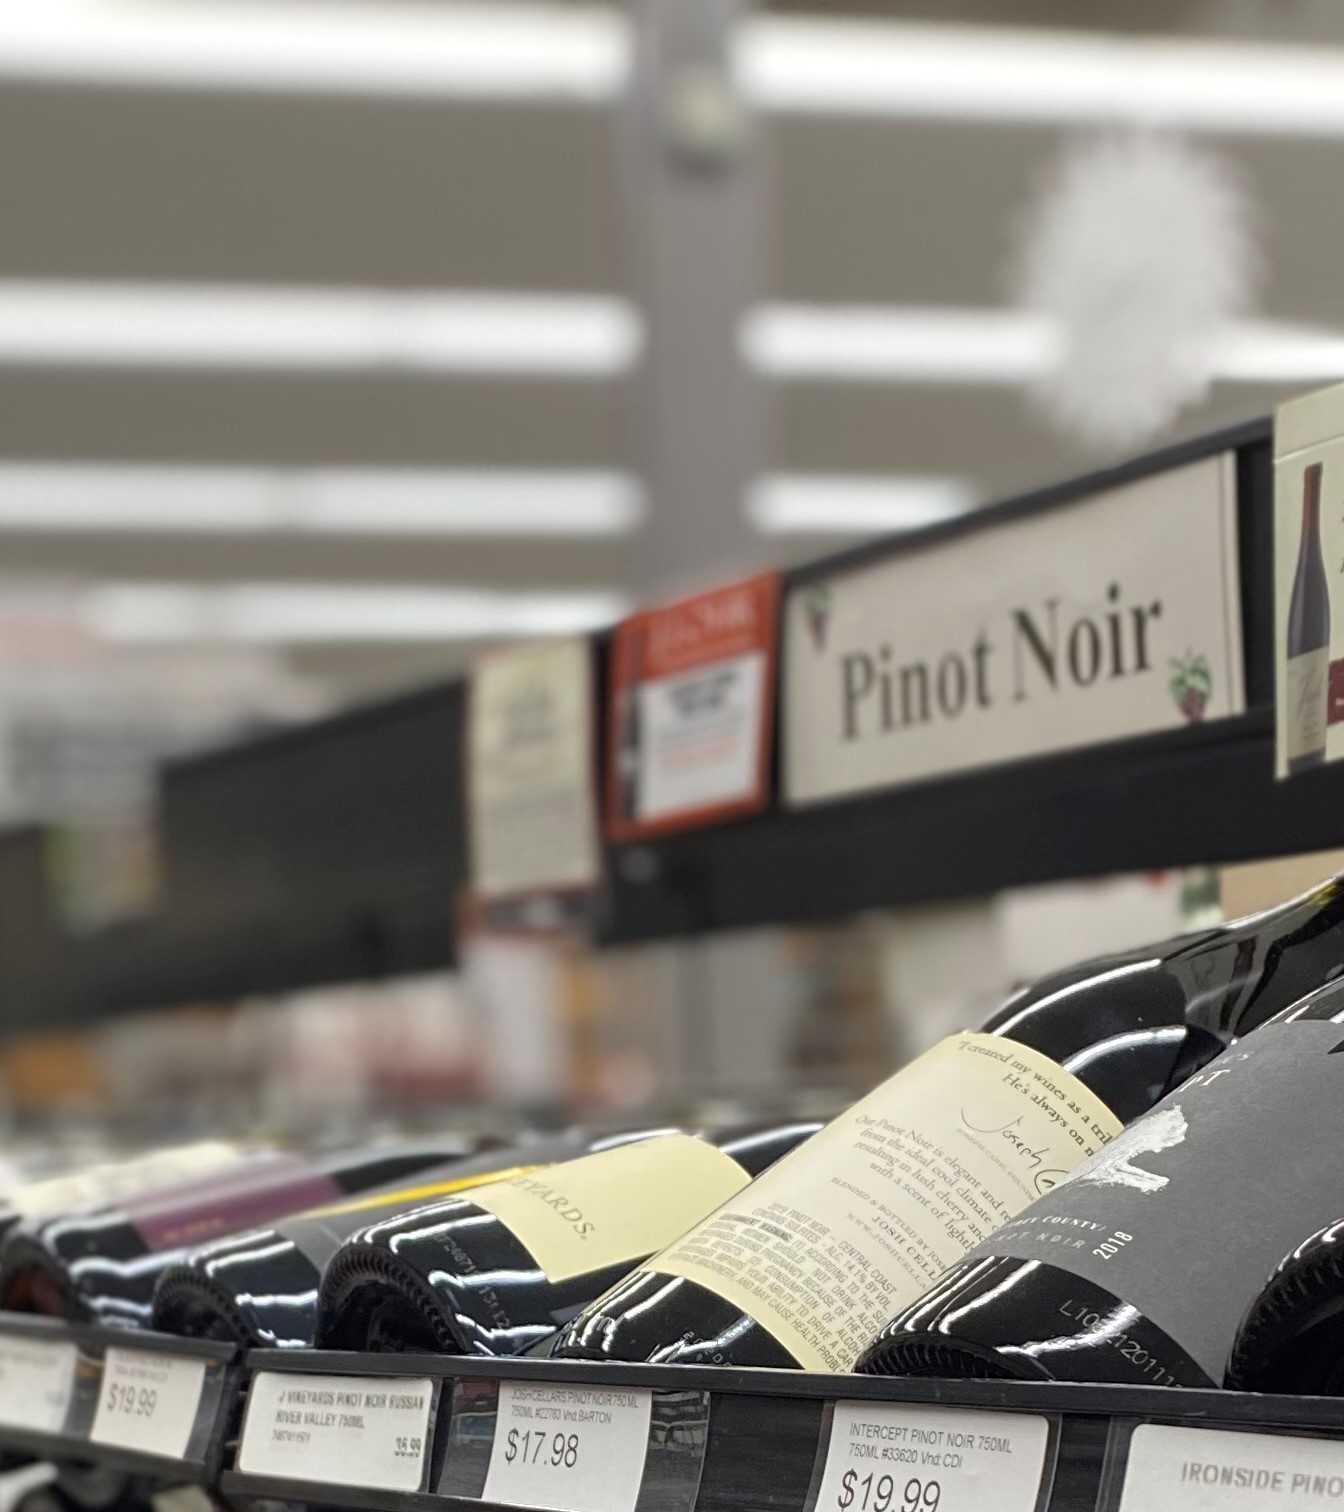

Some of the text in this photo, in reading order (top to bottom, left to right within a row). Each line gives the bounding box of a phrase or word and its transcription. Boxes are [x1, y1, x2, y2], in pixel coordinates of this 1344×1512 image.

[841, 624, 991, 743] Pinot
[1012, 581, 1163, 702] Noir
[1031, 1091, 1070, 1135] always
[944, 1153, 981, 1190] elegant
[980, 1187, 1004, 1211] and
[935, 1189, 970, 1227] cherry
[955, 1185, 994, 1226] climate
[1092, 1231, 1134, 1260] 2018
[106, 1382, 158, 1418] $19.99
[288, 1390, 335, 1406] VINEYARDS
[337, 1393, 364, 1408] PINOT
[364, 1394, 388, 1409] NOIR
[388, 1395, 425, 1411] RUSSIAN
[532, 1389, 566, 1404] CELLARS
[568, 1391, 590, 1406] PINOT
[275, 1410, 301, 1425] RIVER
[304, 1412, 338, 1427] VALLEY
[579, 1411, 613, 1424] BARTON
[505, 1427, 579, 1468] $17.98
[849, 1422, 1013, 1454] INTERCEPT PINOT NOIR 750ML
[848, 1442, 880, 1460] 750ML
[880, 1446, 919, 1464] #33620
[942, 1453, 964, 1469] CDI
[1181, 1461, 1284, 1492] IRONSIDE
